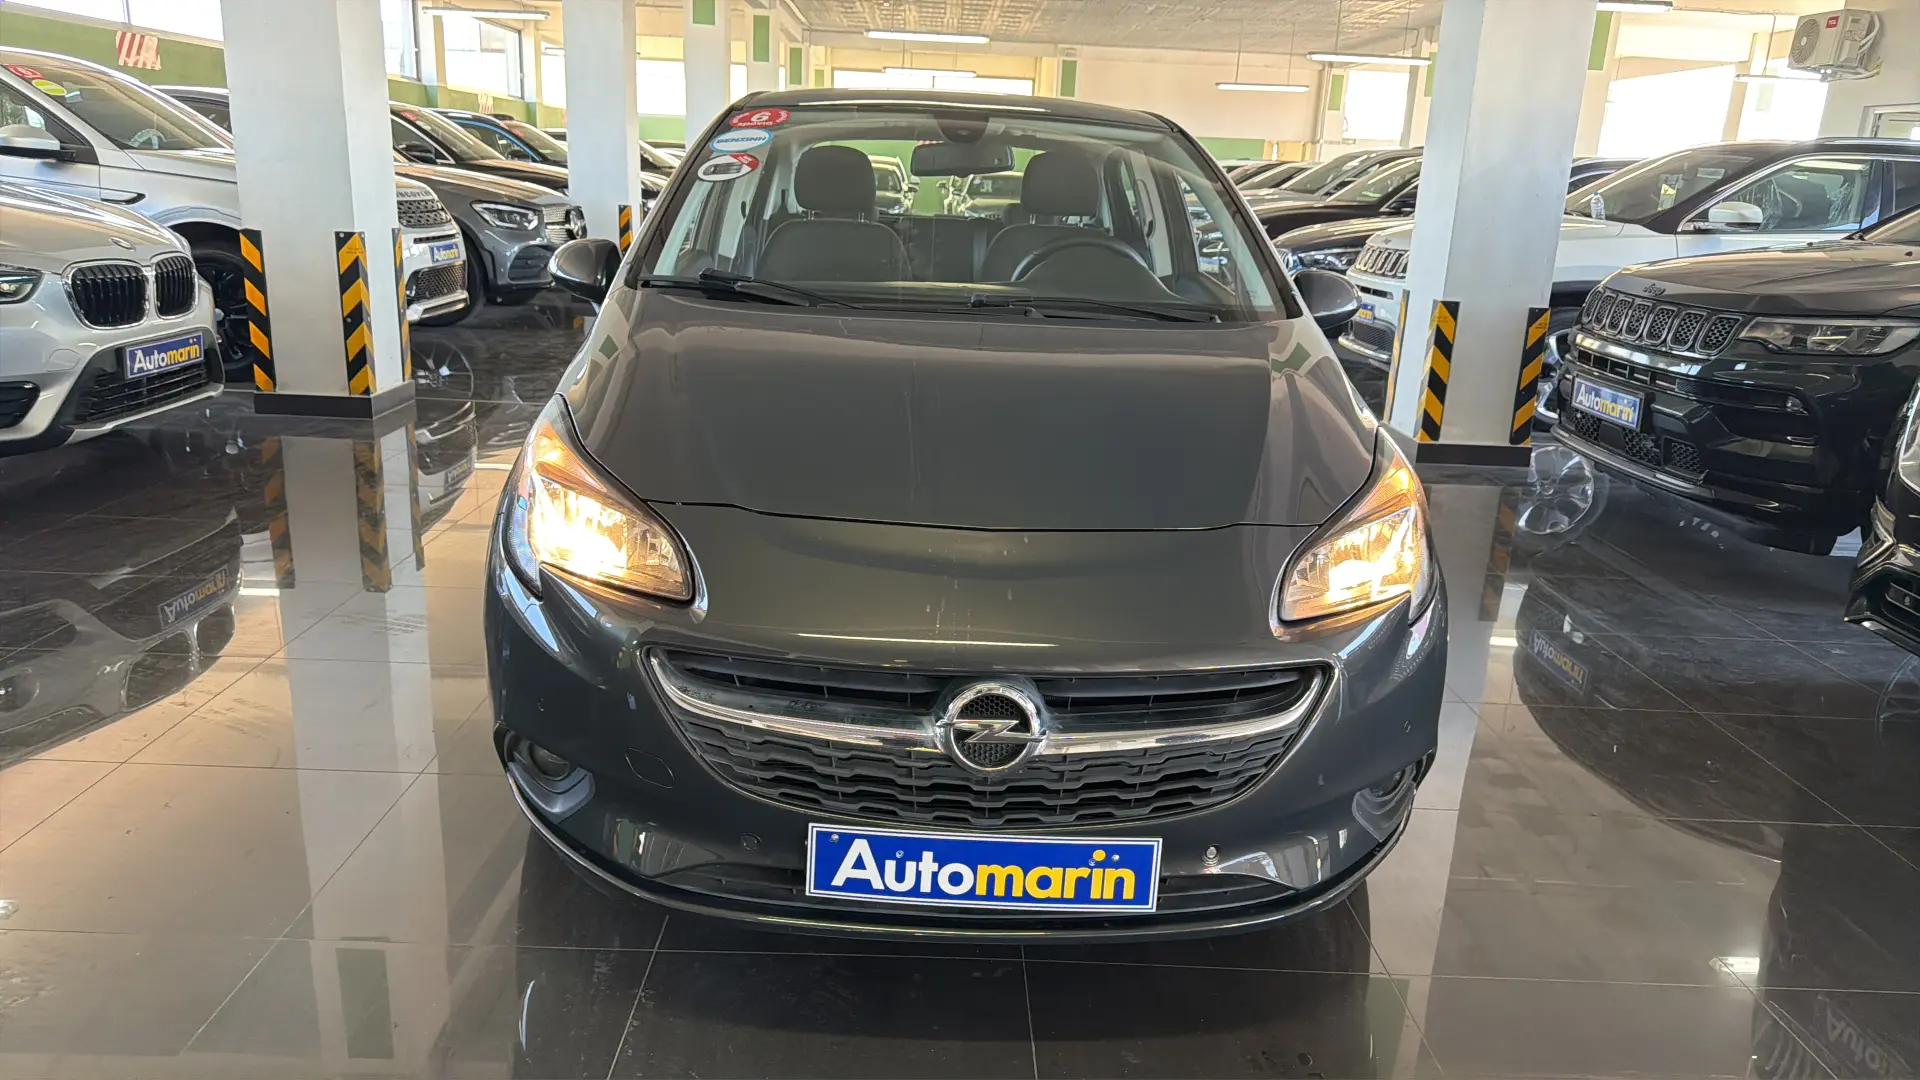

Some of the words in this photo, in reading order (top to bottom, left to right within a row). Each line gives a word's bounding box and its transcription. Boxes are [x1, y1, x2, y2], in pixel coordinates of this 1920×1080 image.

[751, 111, 772, 122] 6
[133, 338, 200, 373] Automarin
[1577, 384, 1634, 422] Automarin
[830, 838, 1136, 900] Automarin
